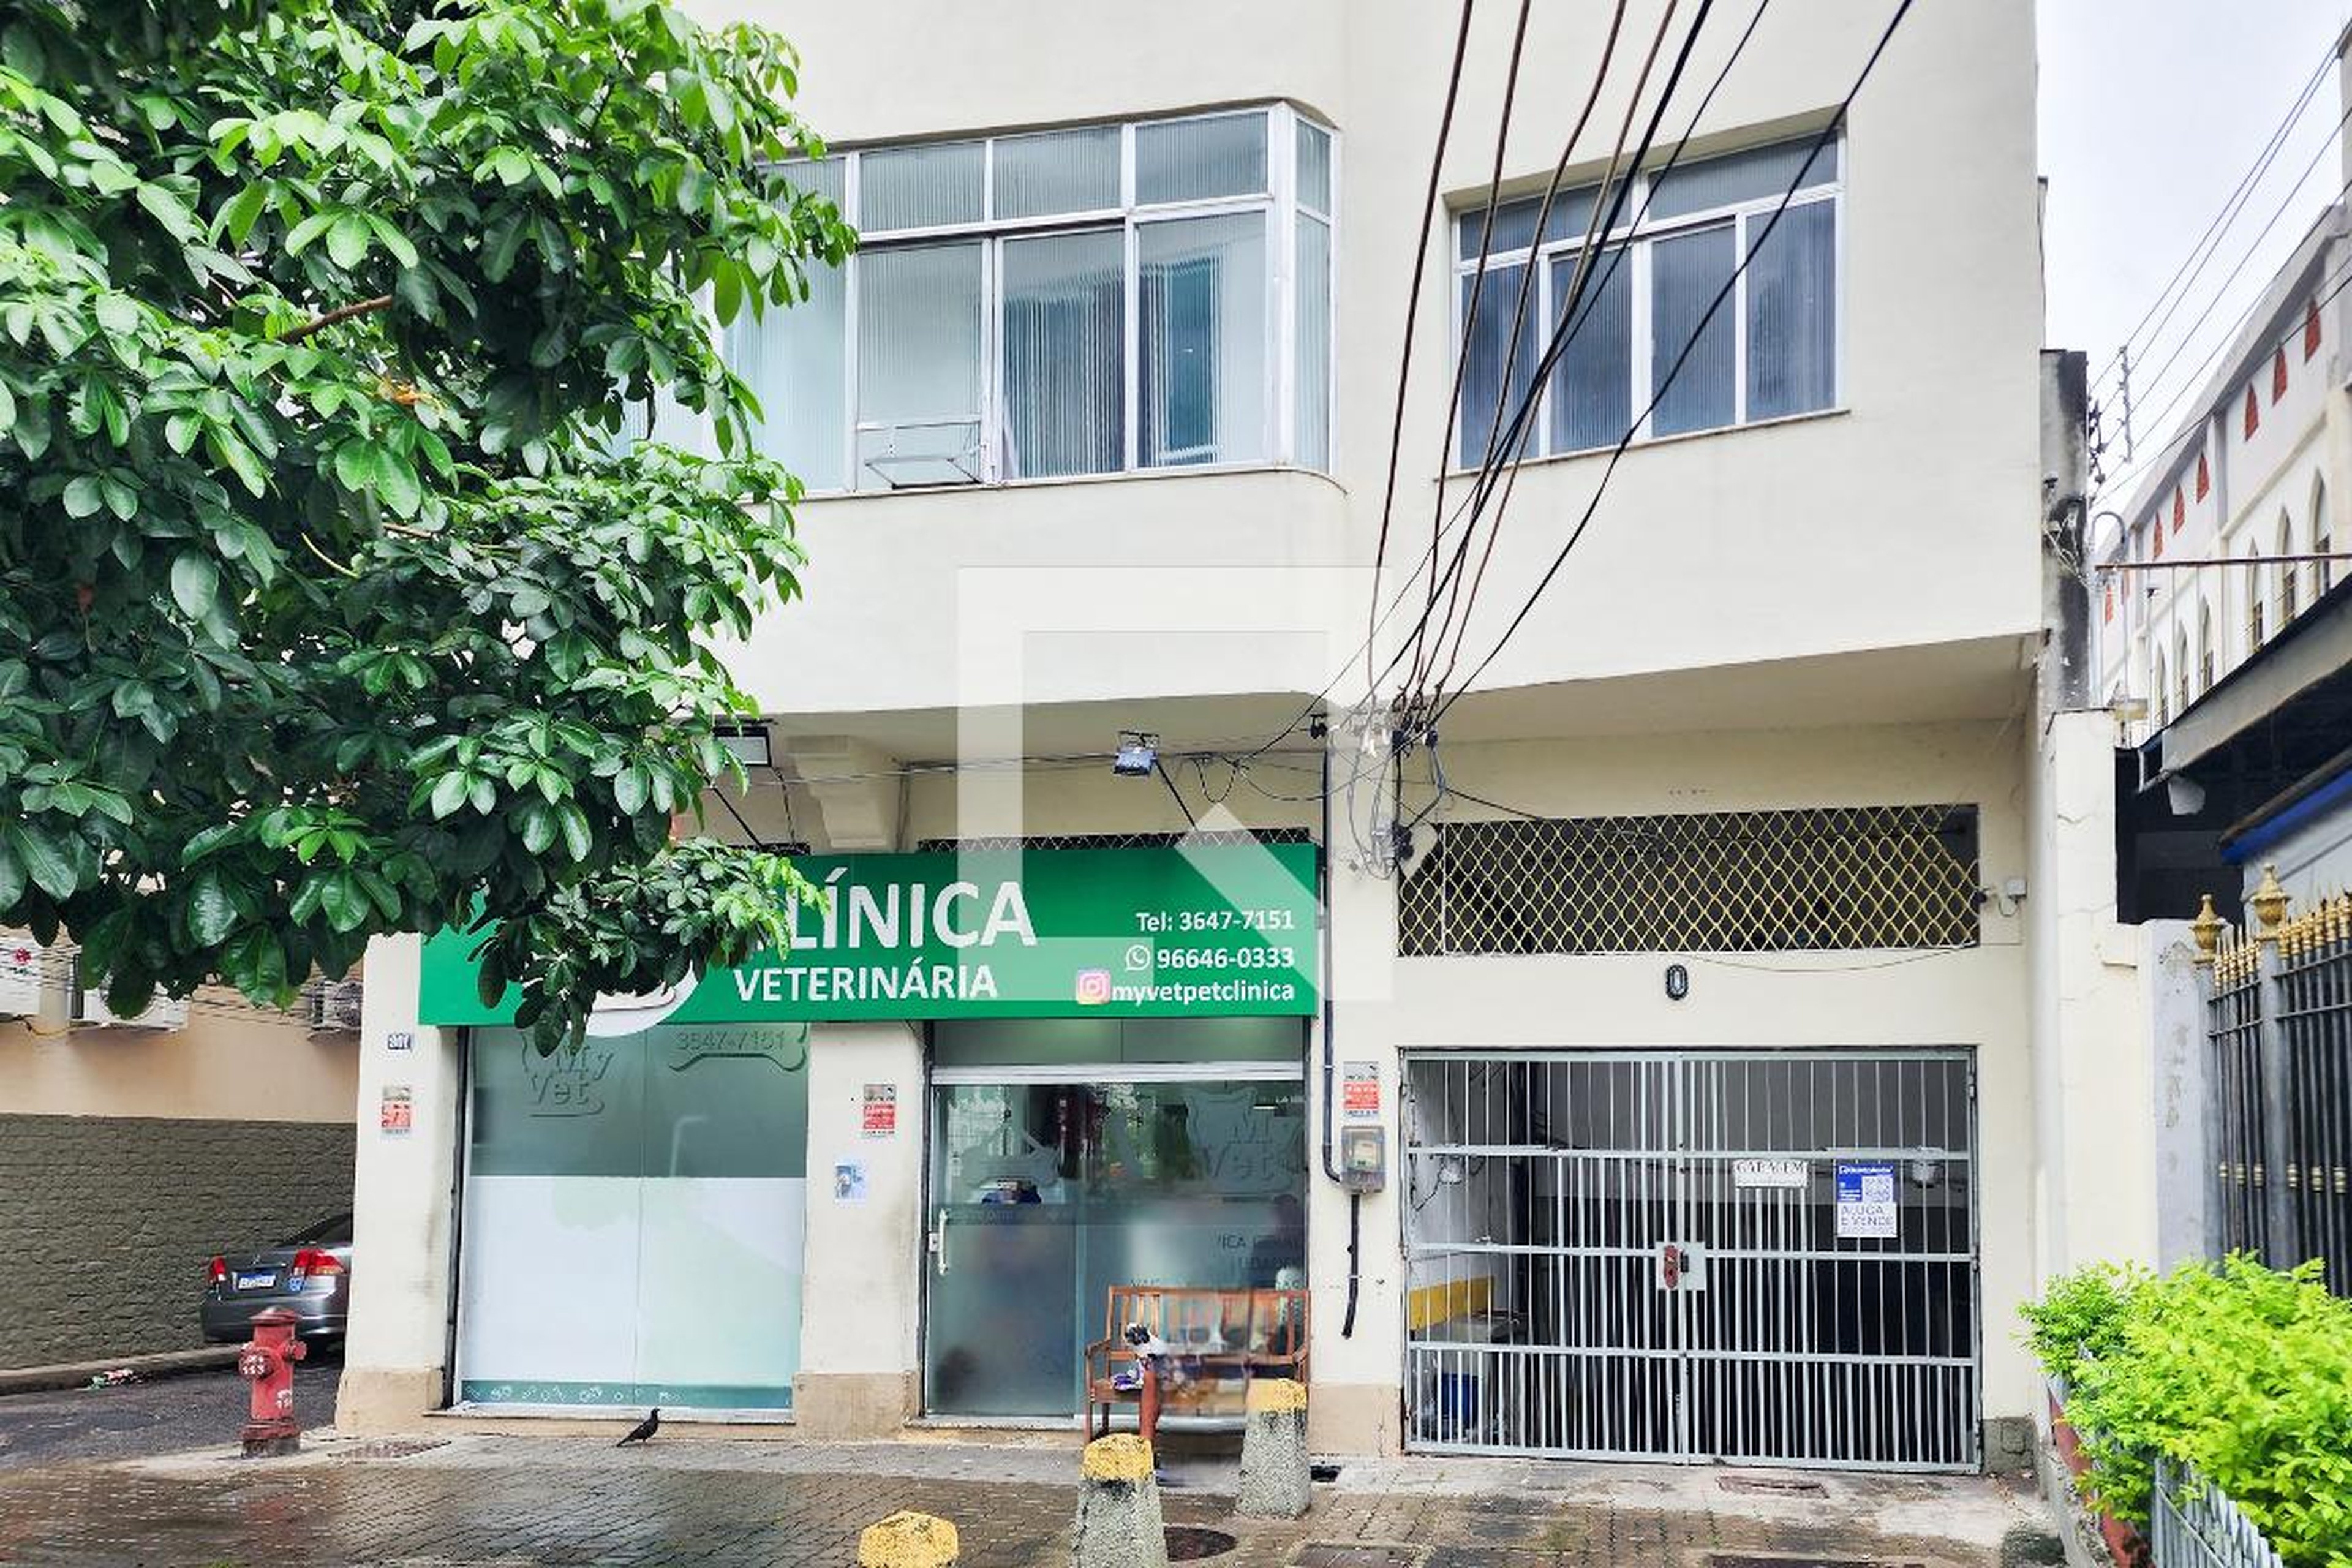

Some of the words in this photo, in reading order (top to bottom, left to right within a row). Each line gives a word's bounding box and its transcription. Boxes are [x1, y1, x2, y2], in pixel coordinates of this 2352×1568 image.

[756, 867, 1039, 950] LÍNICA
[1136, 911, 1172, 932] Tel:
[1179, 910, 1294, 930] 3647-7151
[1157, 948, 1294, 968] 96646-0333
[735, 957, 998, 1002] VETERINÁRIA
[1112, 981, 1294, 1006] myvetpetclinica
